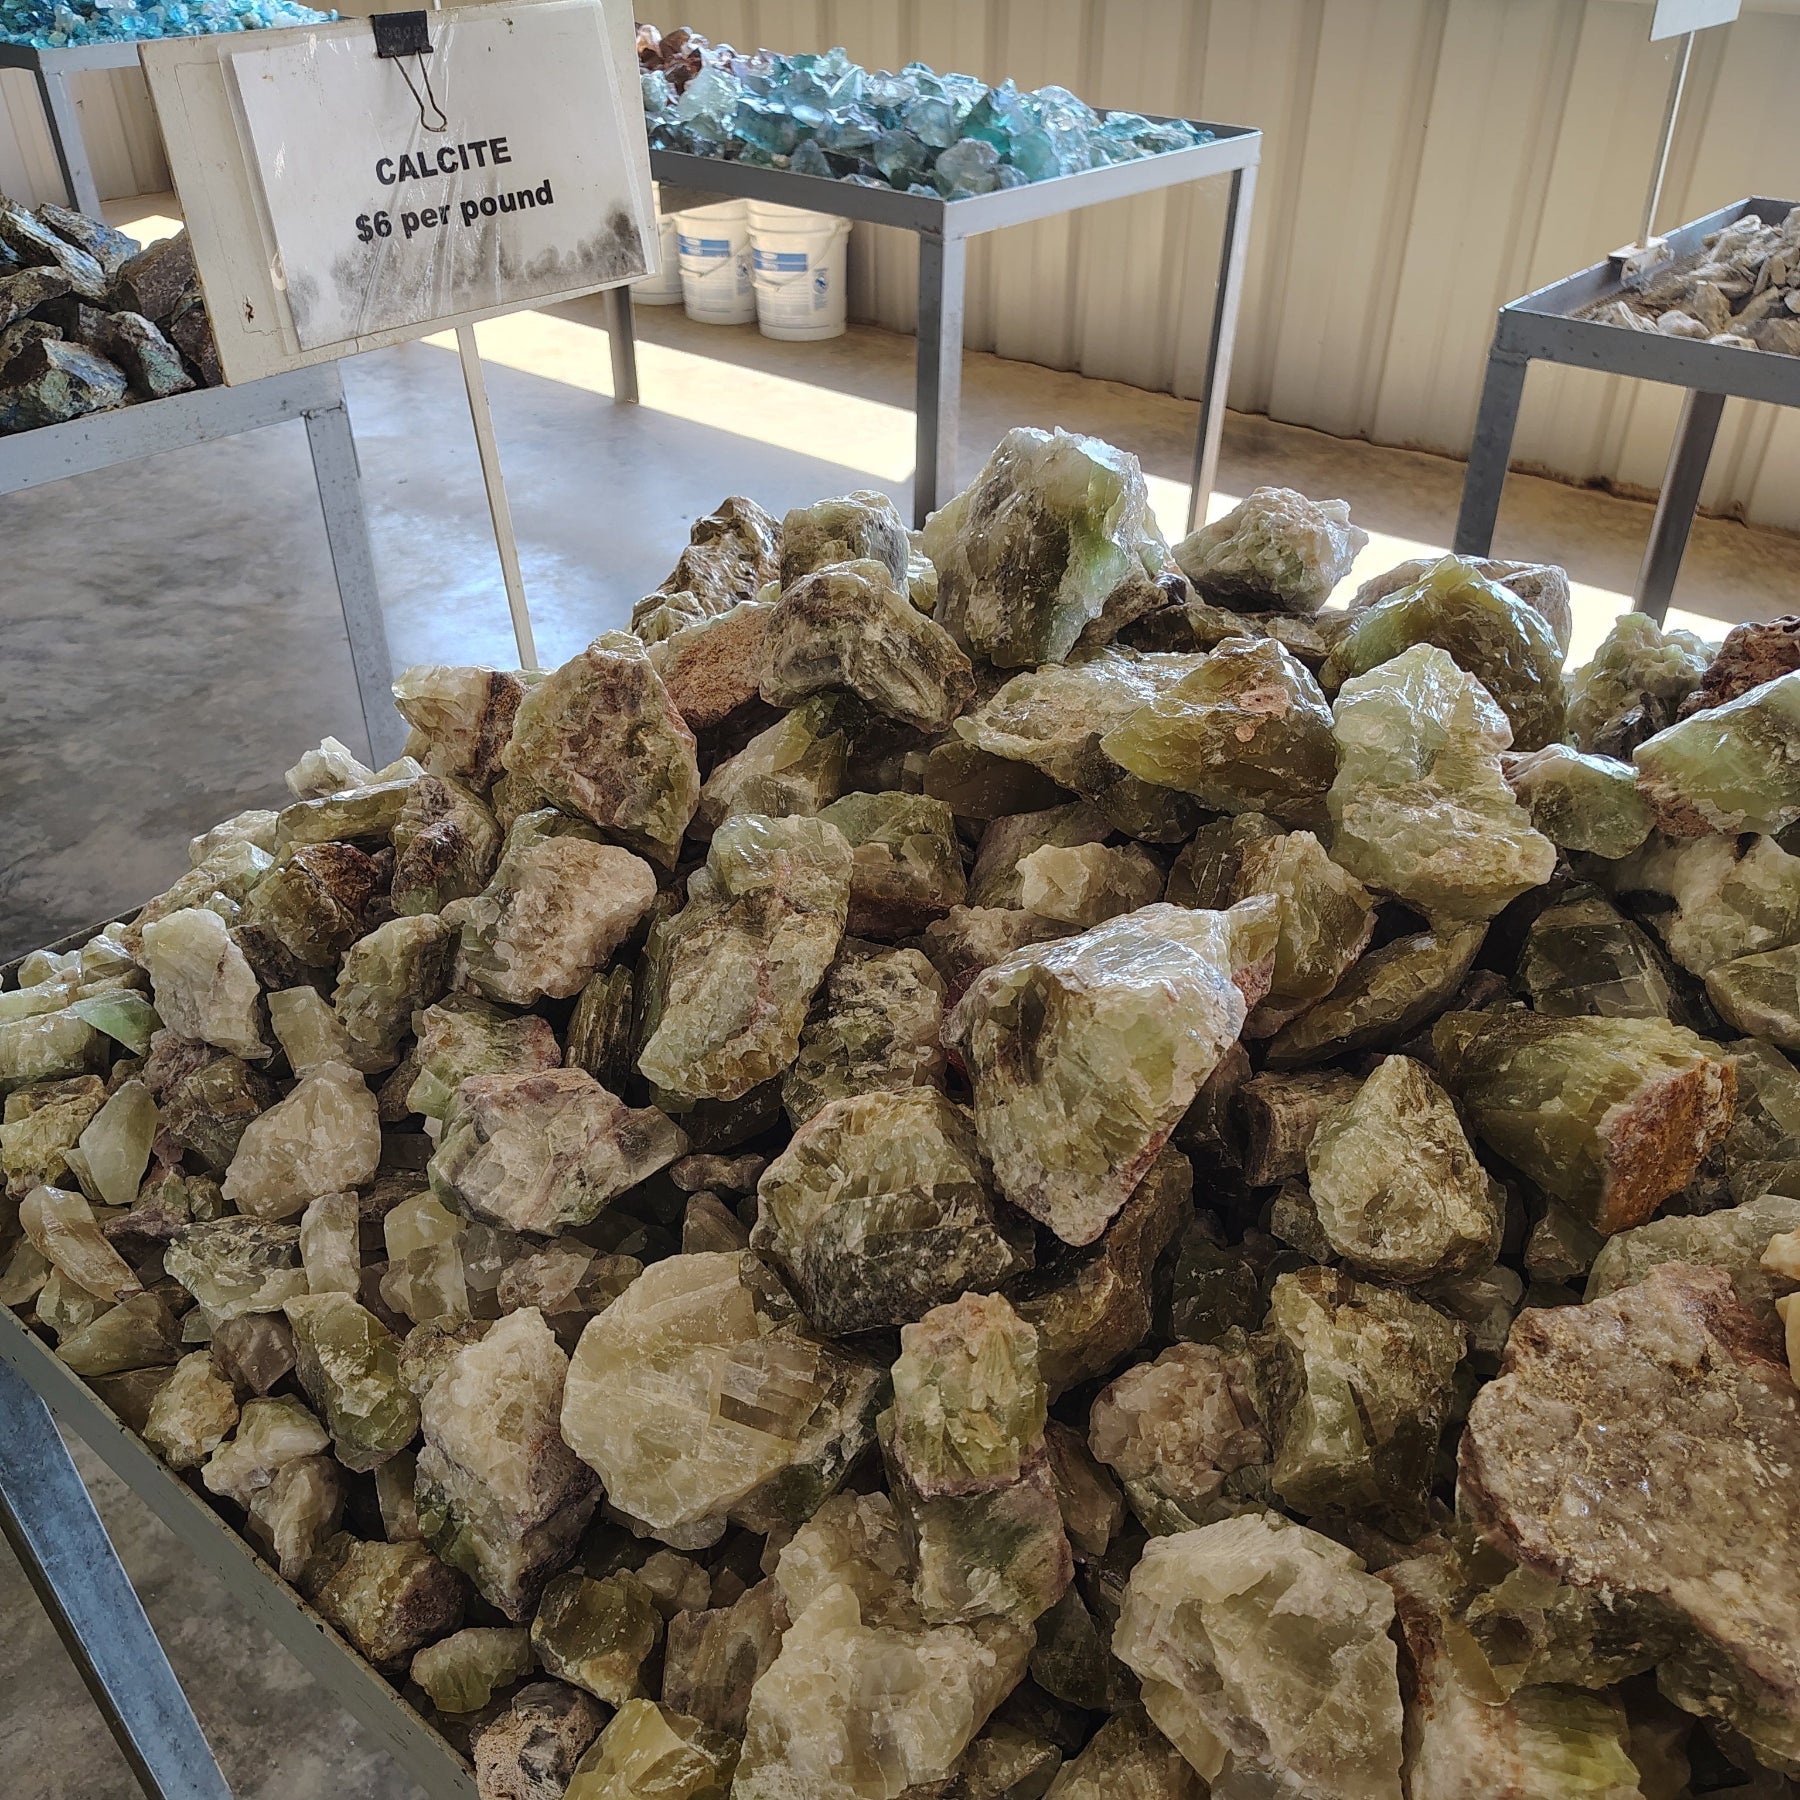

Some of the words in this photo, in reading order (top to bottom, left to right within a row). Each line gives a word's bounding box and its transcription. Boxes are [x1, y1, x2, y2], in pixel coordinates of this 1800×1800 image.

[376, 137, 512, 186] CALCITE
[355, 210, 392, 243] $6
[401, 204, 451, 239] per
[460, 179, 554, 227] pound
